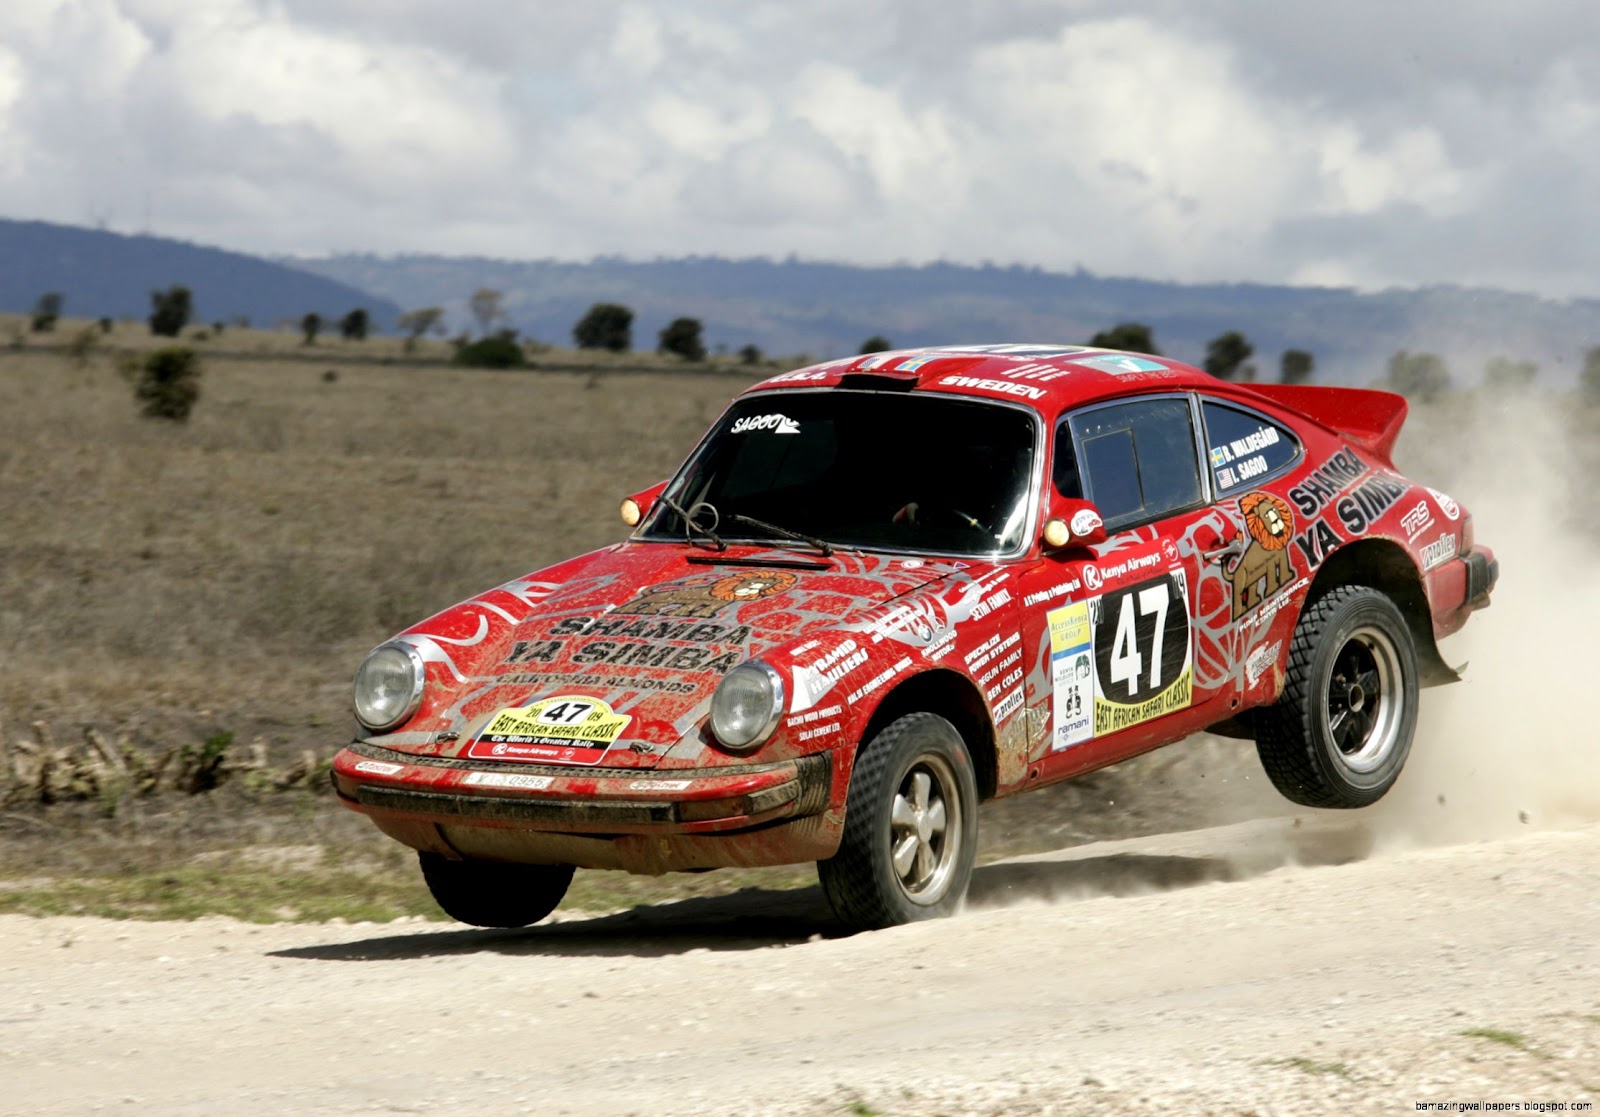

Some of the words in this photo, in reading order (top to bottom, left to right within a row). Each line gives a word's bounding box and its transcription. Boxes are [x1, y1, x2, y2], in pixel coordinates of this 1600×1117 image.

[938, 374, 1047, 400] SWEDEN
[730, 414, 784, 434] SAGOO
[1221, 445, 1235, 463] B.
[1237, 455, 1268, 480] SAGOO
[1289, 445, 1369, 517] SHAMBA
[1296, 519, 1341, 567] YA
[1338, 472, 1411, 534] SIMBA
[1100, 564, 1127, 580] Kenya
[1127, 552, 1161, 571] Airways
[986, 588, 1012, 611] FAMILY
[1239, 614, 1258, 633] PUMP
[1260, 577, 1310, 616] MAINTENANCE
[549, 616, 752, 645] SHAMBA
[1051, 613, 1088, 631] AccessKenya
[1060, 628, 1082, 641] GROUP
[1110, 583, 1169, 696] 47
[504, 641, 564, 663] YA
[572, 641, 741, 674] SIMBA
[803, 639, 857, 679] PYRAMID
[968, 653, 990, 675] POWER
[989, 631, 1020, 659] SYSTEMS
[999, 647, 1022, 672] FAMILY
[496, 673, 600, 686] CALIFORNIA
[603, 676, 696, 694] ALMONDS
[810, 647, 869, 695] HAULIERS
[987, 683, 1002, 702] BEN
[1002, 666, 1023, 689] COLES
[525, 708, 542, 718] 20
[544, 702, 592, 723] 47
[587, 712, 603, 722] 09
[804, 711, 818, 723] WOOD
[818, 704, 842, 719] PRODUCTS
[1000, 690, 1023, 718] proflex
[1096, 701, 1112, 733] EAST
[1113, 705, 1140, 730] AFRICAN
[1142, 695, 1165, 719] SAFARI
[1165, 672, 1190, 710] CLASSIC
[491, 714, 517, 732] EAST
[513, 719, 549, 735] AFRICAN
[549, 724, 582, 737] SAFARI
[582, 722, 624, 739] CLASSIC
[813, 724, 832, 738] CEMENT
[1058, 715, 1089, 735] ramani
[571, 740, 594, 749] Rally
